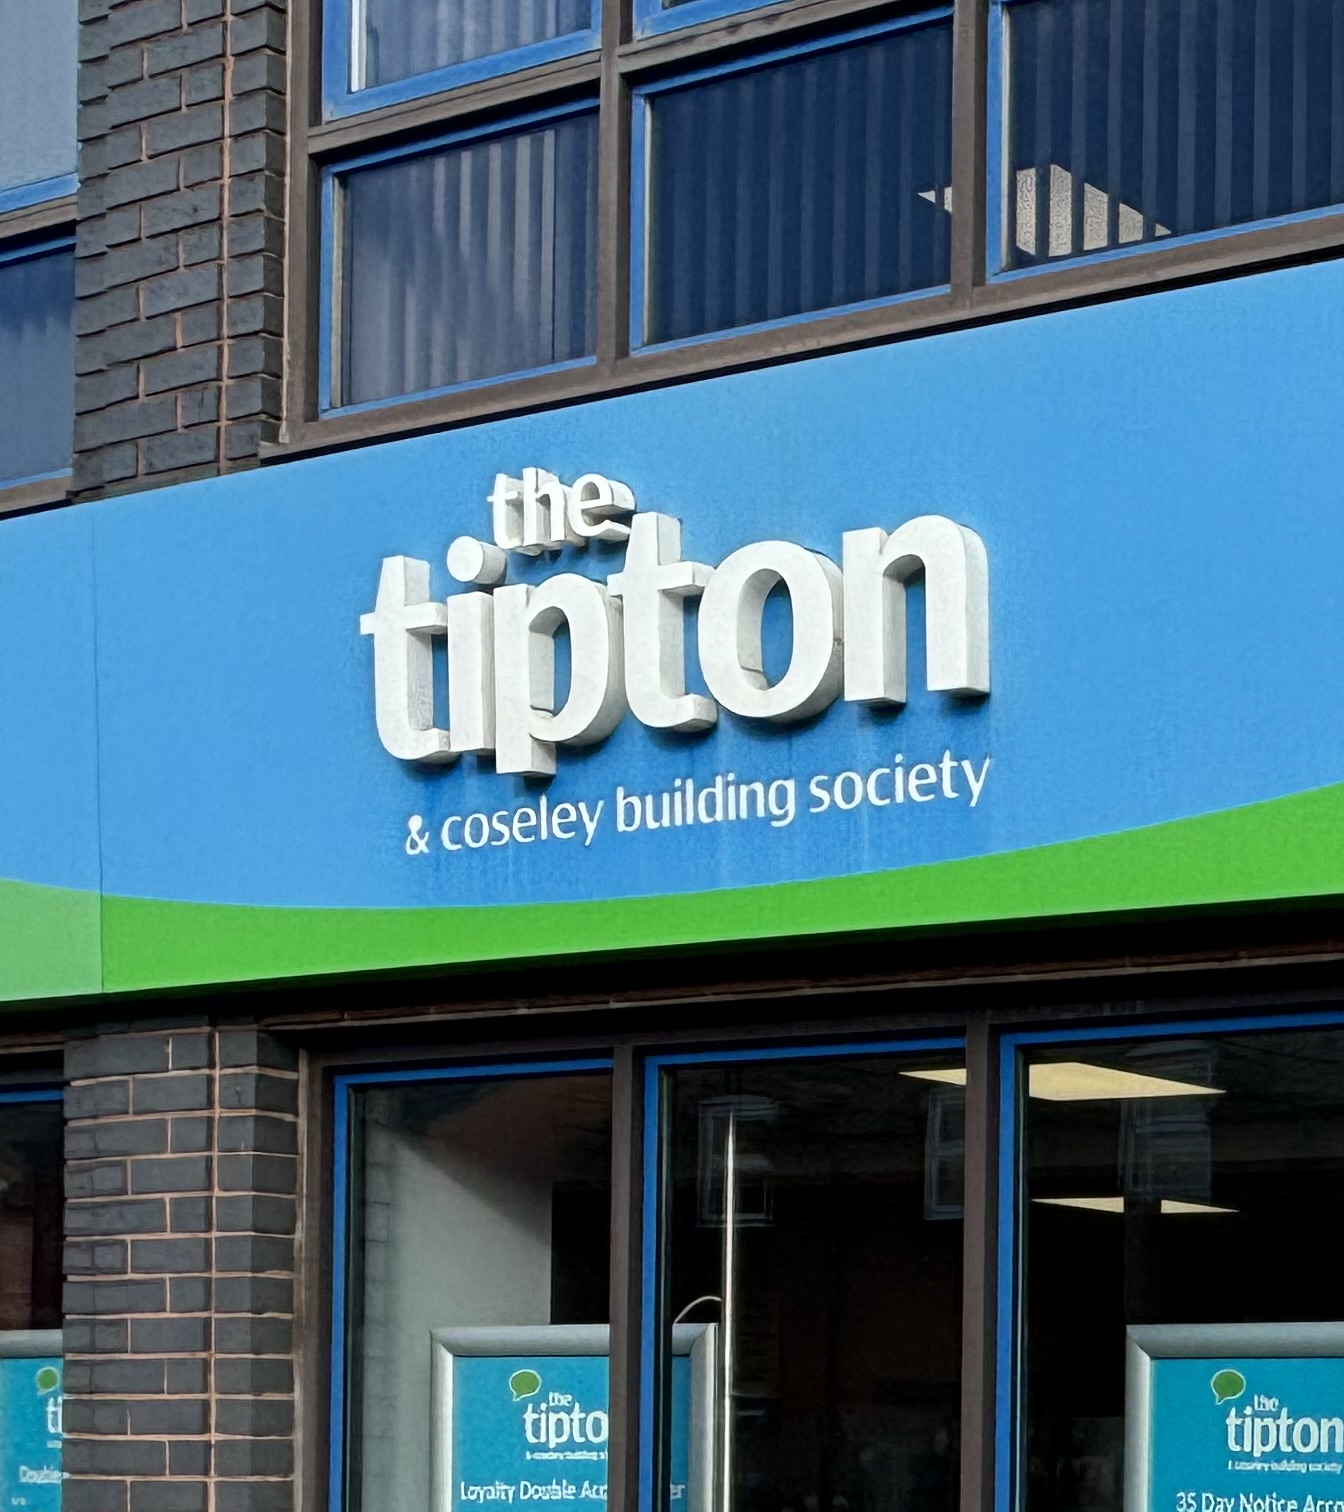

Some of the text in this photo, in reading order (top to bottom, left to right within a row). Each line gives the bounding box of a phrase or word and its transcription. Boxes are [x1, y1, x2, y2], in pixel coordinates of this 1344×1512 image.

[487, 467, 636, 551] the
[360, 512, 990, 777] tipton
[404, 750, 992, 855] & coseley building society
[523, 1402, 609, 1448] tipto
[1226, 1407, 1344, 1457] tipton
